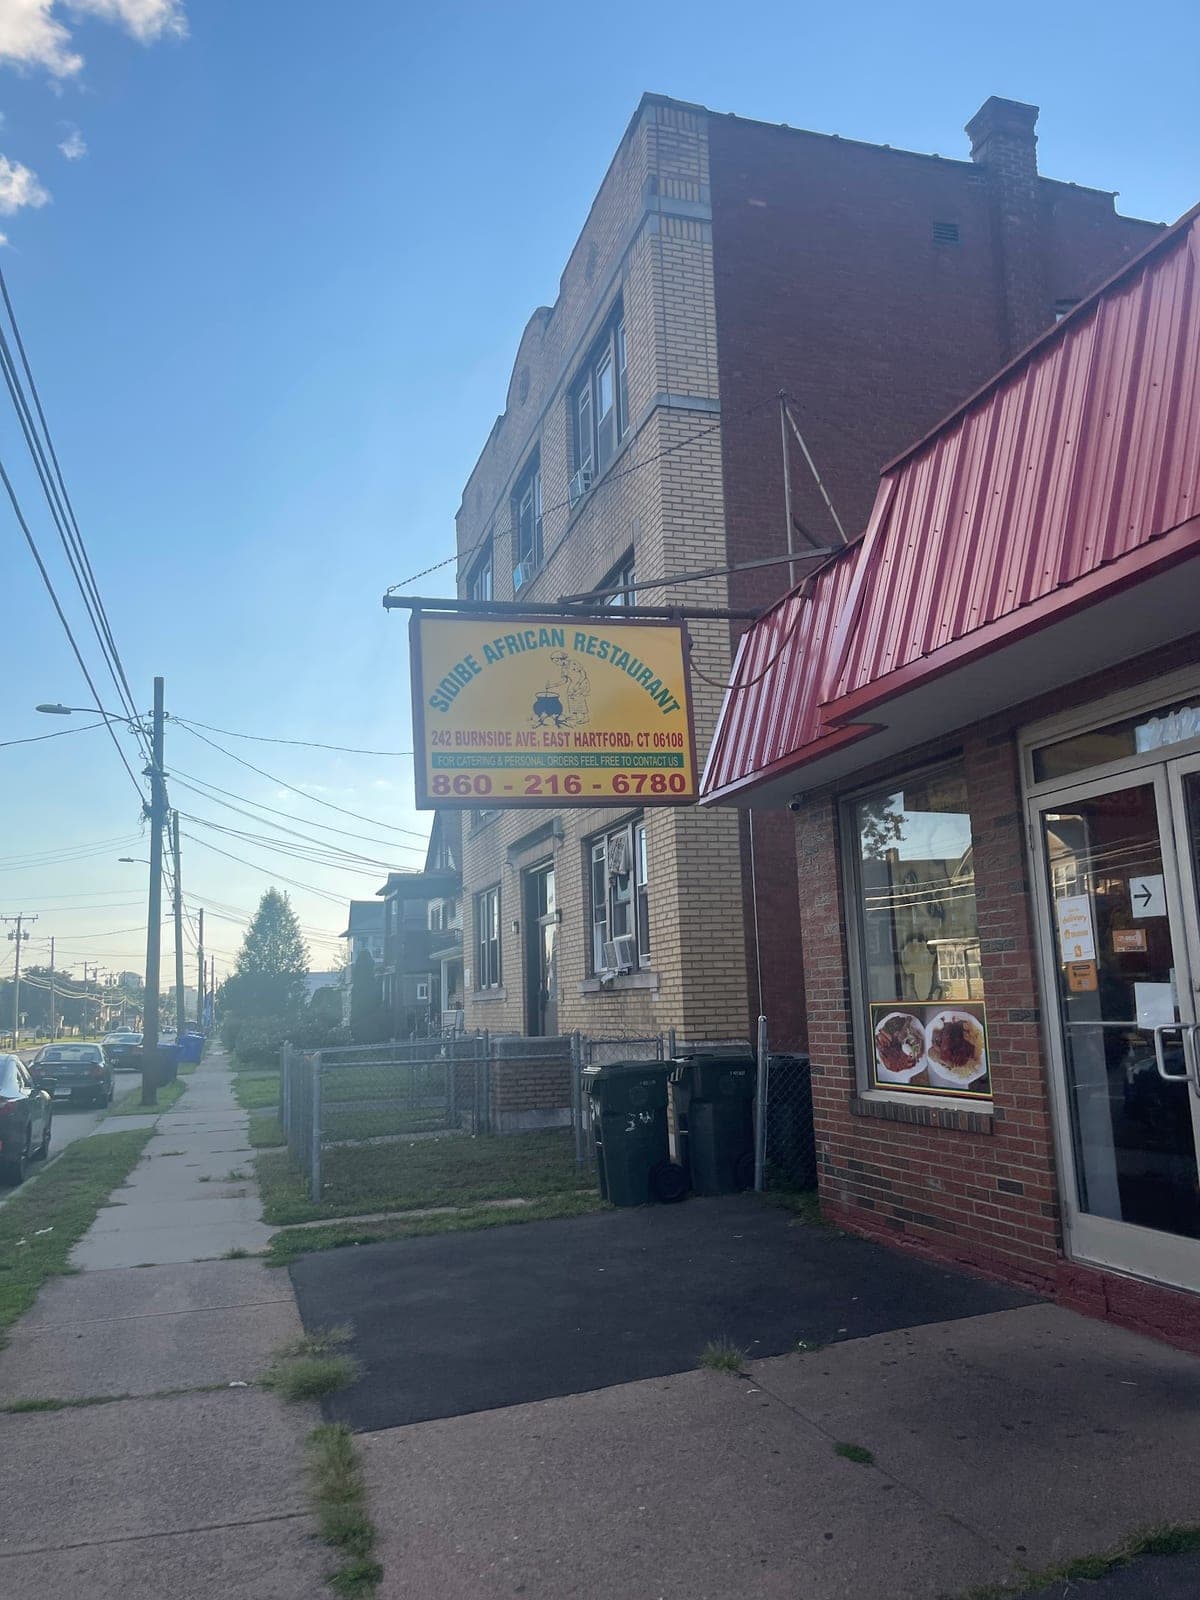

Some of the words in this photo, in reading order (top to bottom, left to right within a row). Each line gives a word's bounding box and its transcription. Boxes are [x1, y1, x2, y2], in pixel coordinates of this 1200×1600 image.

[429, 654, 482, 713] SIDIBE
[482, 628, 565, 664] AFRICAN
[574, 632, 680, 715] RESTAURANT
[432, 730, 452, 746] 242
[455, 731, 513, 747] BURNSIDE
[543, 732, 570, 747] EAST
[637, 733, 650, 747] CT
[653, 732, 684, 748] 06108
[438, 755, 455, 767] FOR
[504, 755, 546, 767] PERSONAL
[547, 755, 579, 767] ORDERS
[580, 755, 600, 767] FEEL
[601, 755, 620, 767] FREE
[622, 755, 632, 766] TO
[633, 755, 667, 766] CONTACT
[668, 755, 679, 766] US
[431, 774, 492, 795] 860
[524, 774, 582, 795] 216
[612, 773, 686, 794] 6780
